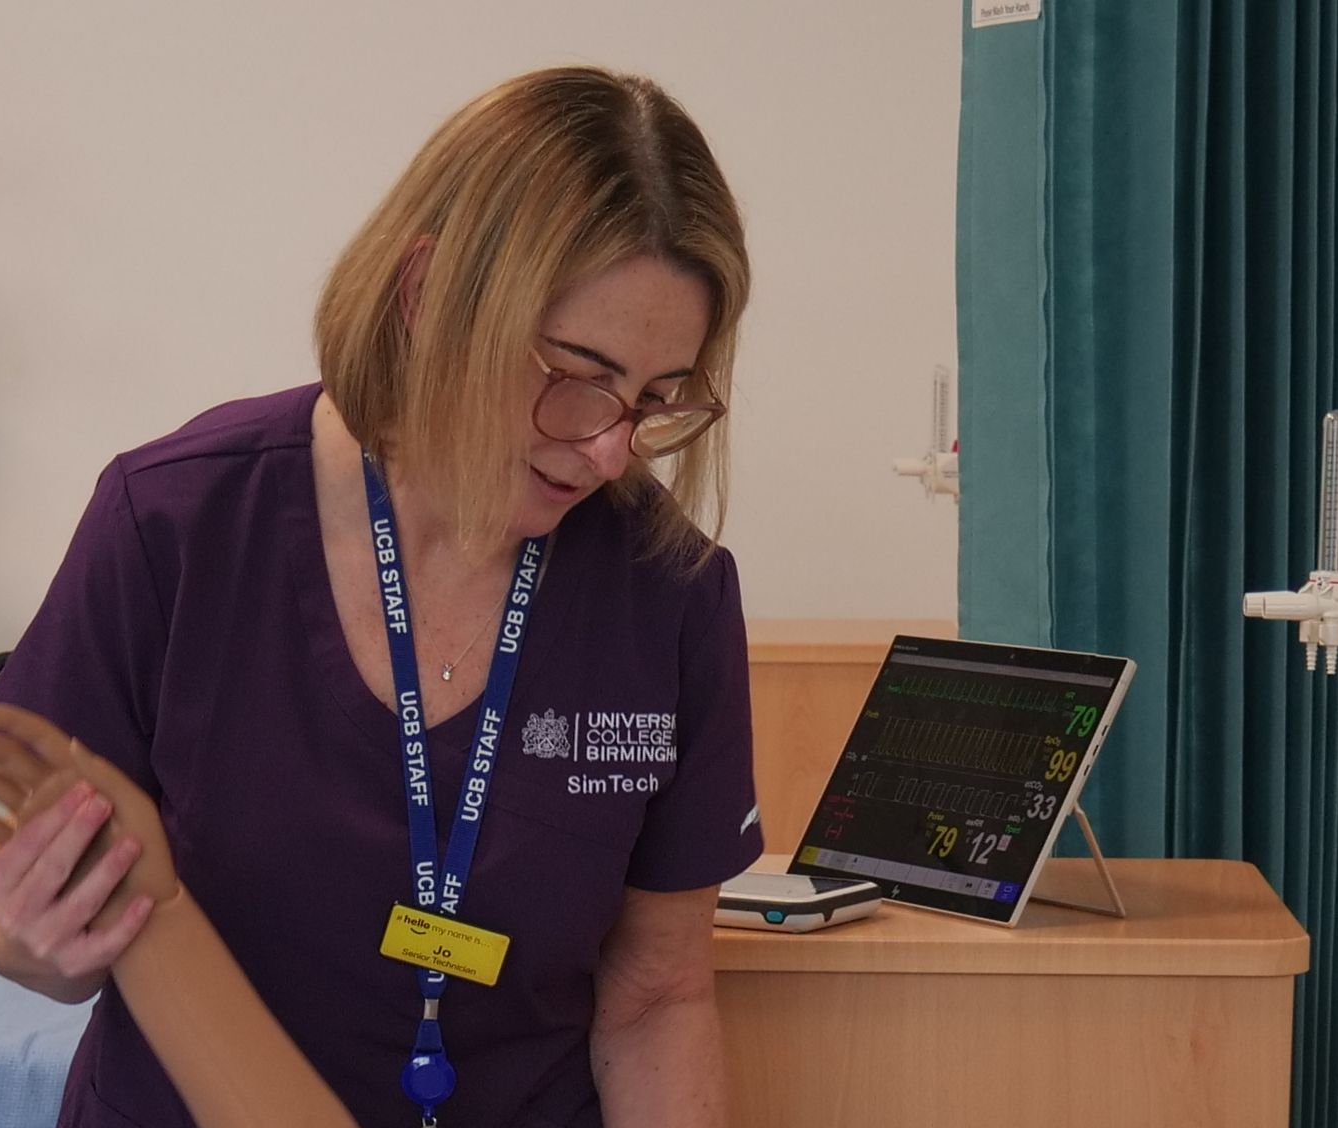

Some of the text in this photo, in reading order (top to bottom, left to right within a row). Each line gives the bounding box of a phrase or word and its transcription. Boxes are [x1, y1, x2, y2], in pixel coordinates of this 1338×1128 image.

[373, 518, 407, 634] UCB STAFF
[500, 541, 541, 654] UCB STAFF
[586, 729, 673, 746] COLLEGE
[1065, 705, 1098, 737] 79
[400, 691, 428, 806] UCB STAFF
[461, 708, 501, 822] UCB STAFF
[1044, 749, 1077, 783] 99
[1027, 793, 1057, 820] 33
[927, 825, 958, 858] 79
[968, 832, 998, 865] 12
[416, 861, 435, 906] UCB
[440, 873, 462, 914] AFF
[431, 924, 447, 936] my
[447, 930, 473, 943] name
[401, 948, 431, 962] Senior
[431, 957, 477, 976] Technician
[432, 945, 452, 958] Jo
